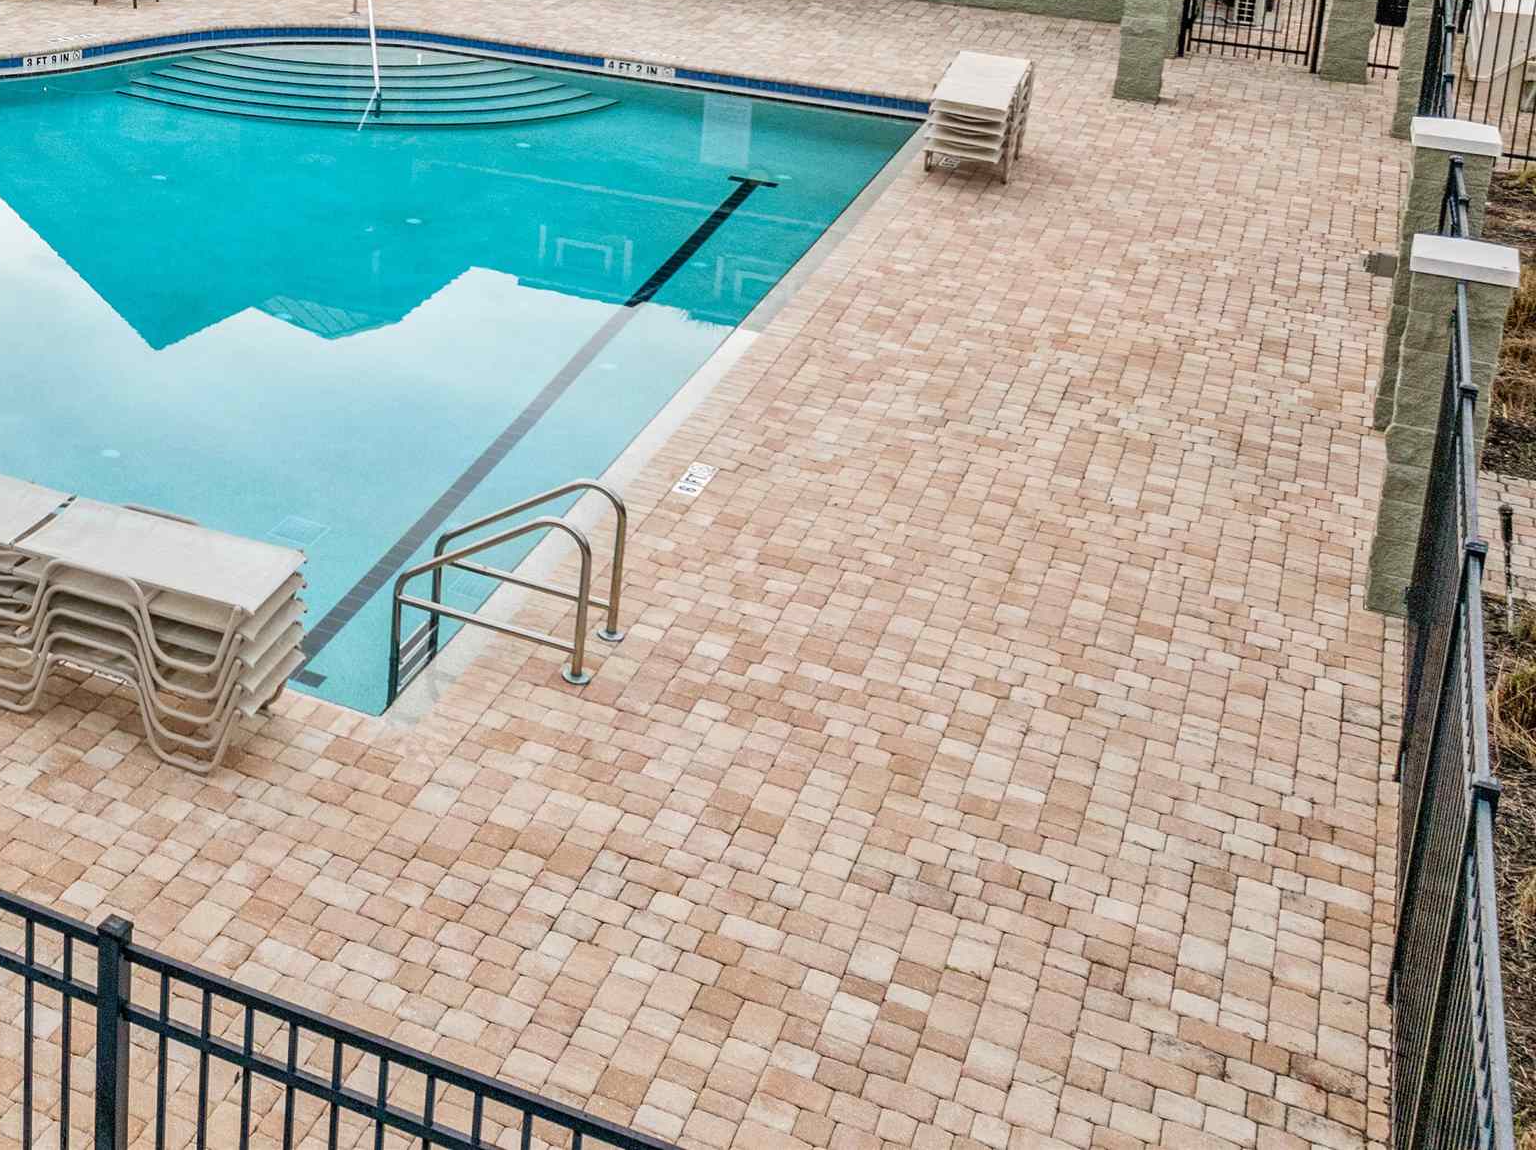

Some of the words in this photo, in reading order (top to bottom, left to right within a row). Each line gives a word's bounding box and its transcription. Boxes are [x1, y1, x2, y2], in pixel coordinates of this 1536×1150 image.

[36, 57, 47, 66] FT
[60, 53, 69, 64] IN
[646, 66, 657, 75] IN
